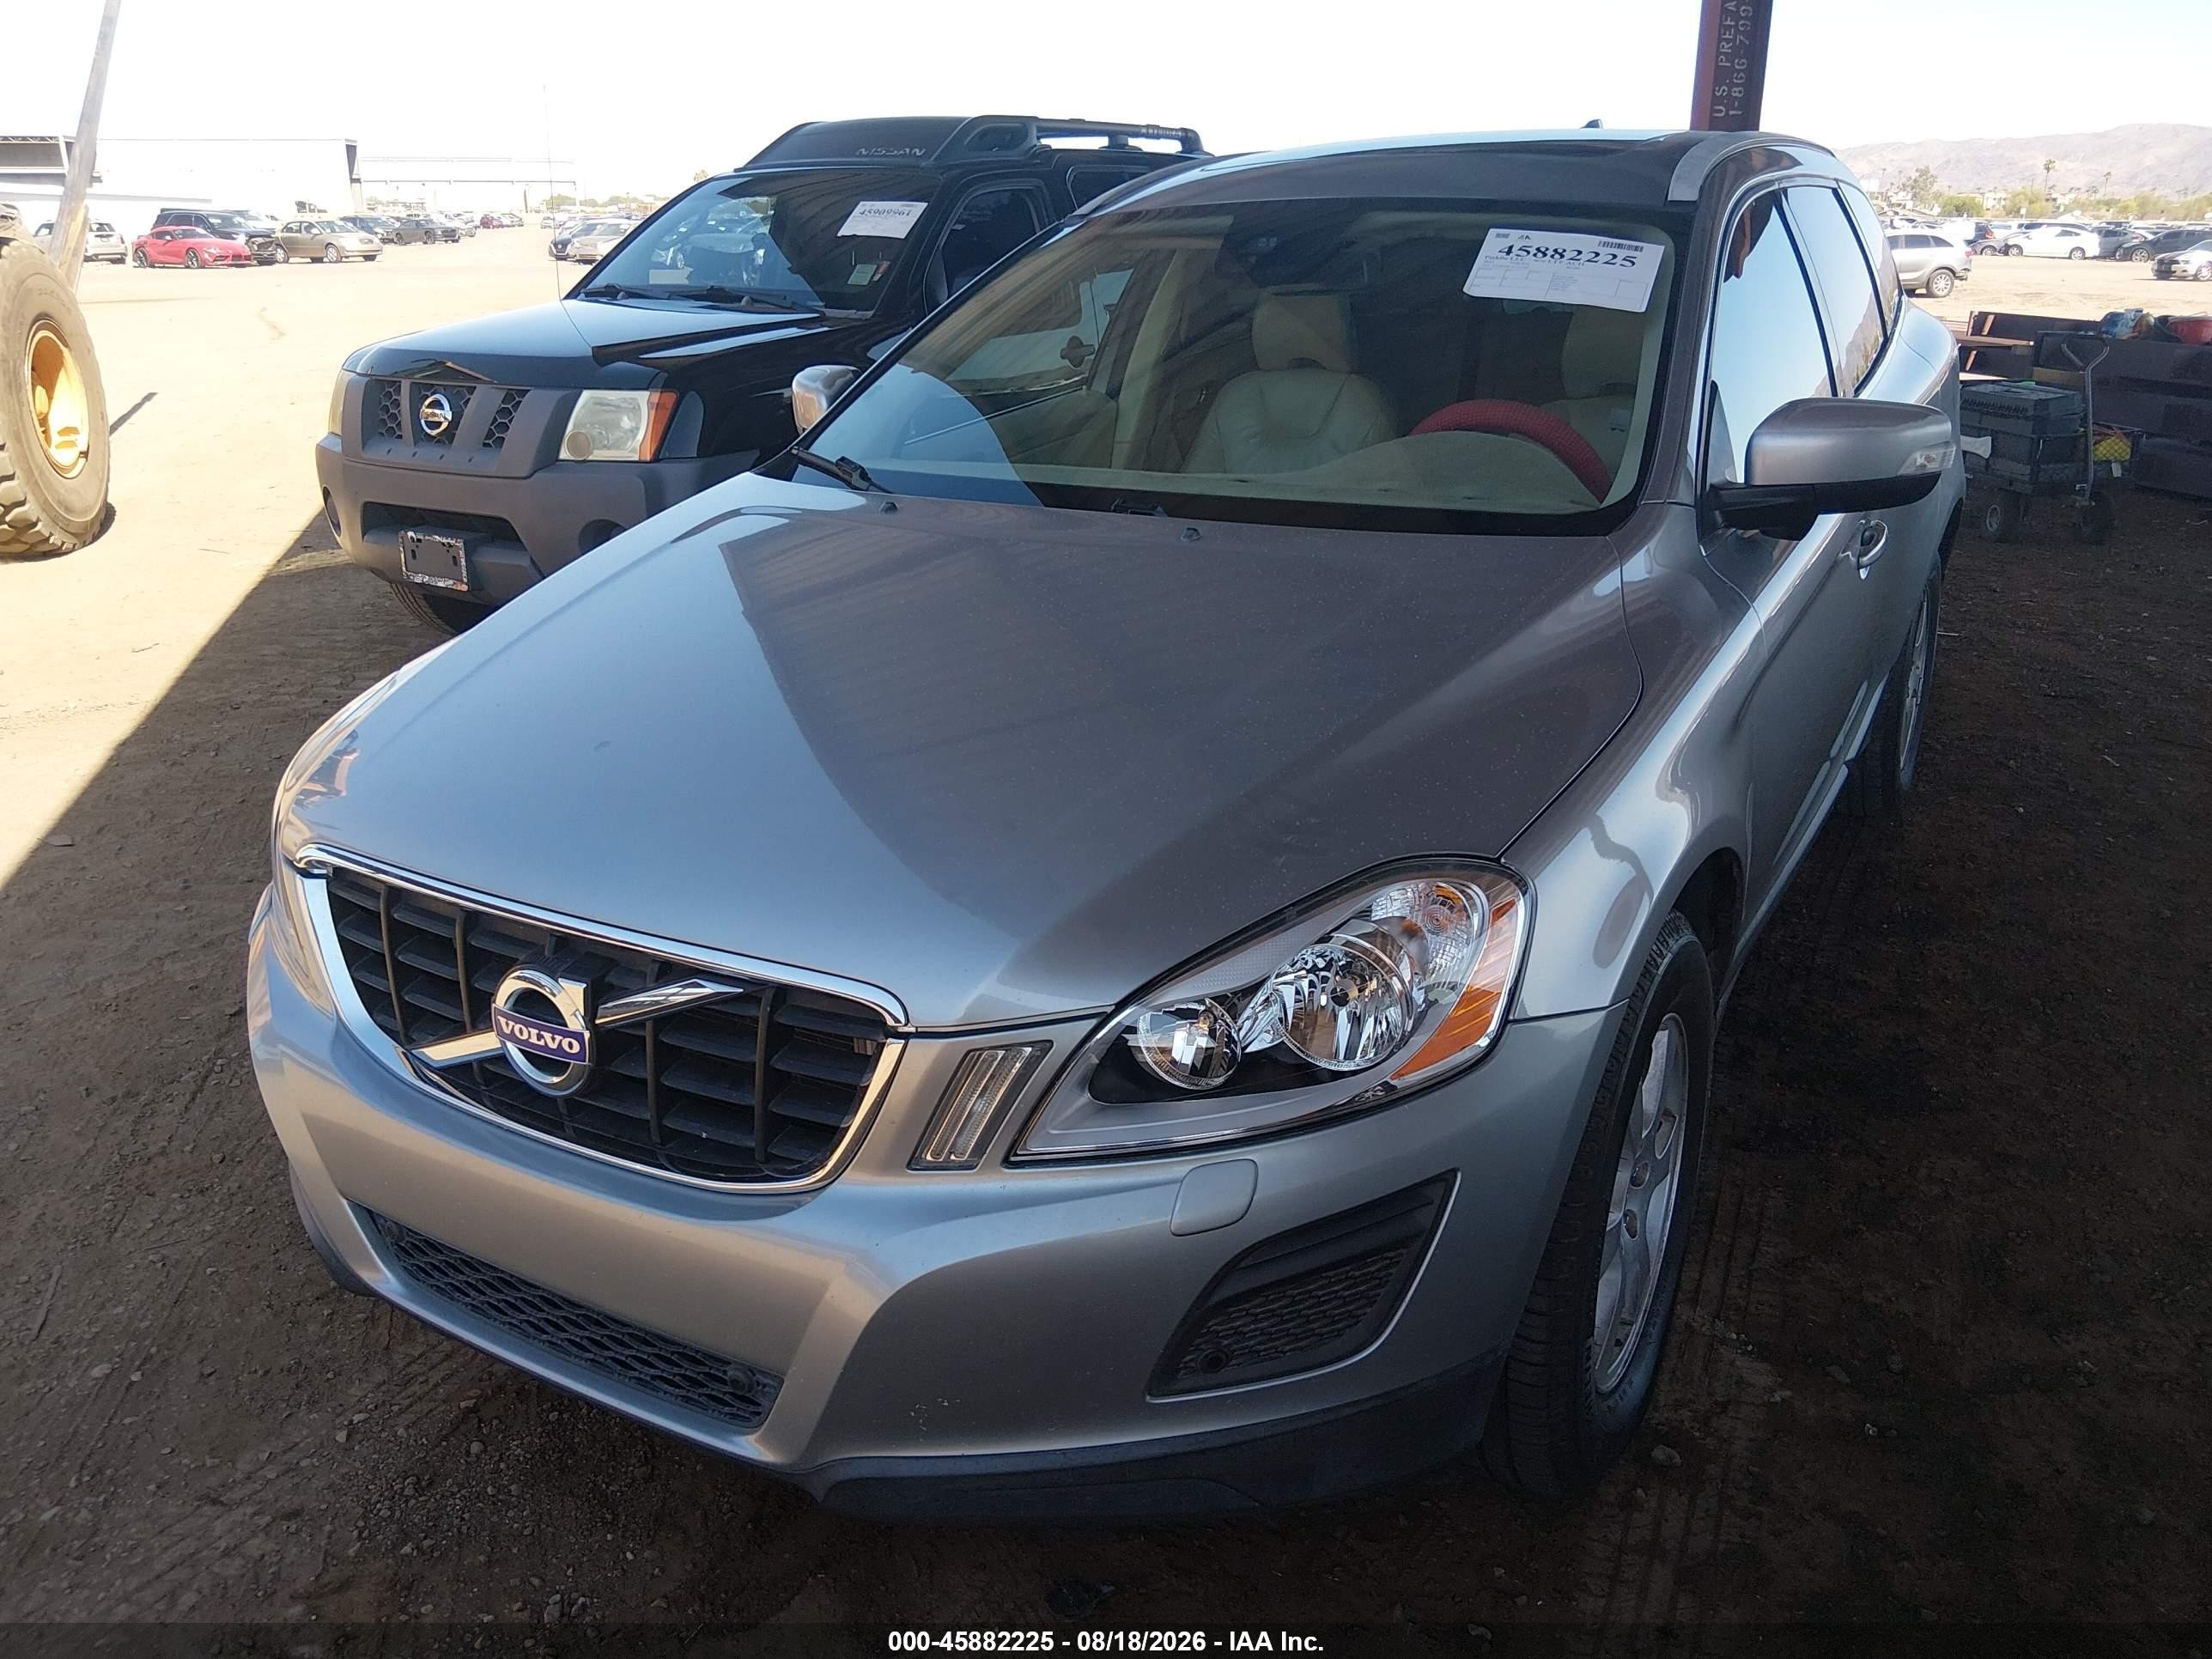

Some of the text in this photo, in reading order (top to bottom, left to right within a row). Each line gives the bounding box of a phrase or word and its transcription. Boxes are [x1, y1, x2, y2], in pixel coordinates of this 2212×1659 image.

[1713, 79, 1730, 117] U.S.
[855, 148, 927, 156] NISSAN
[1498, 244, 1638, 268] 45882225
[497, 1015, 580, 1054] VOLVO
